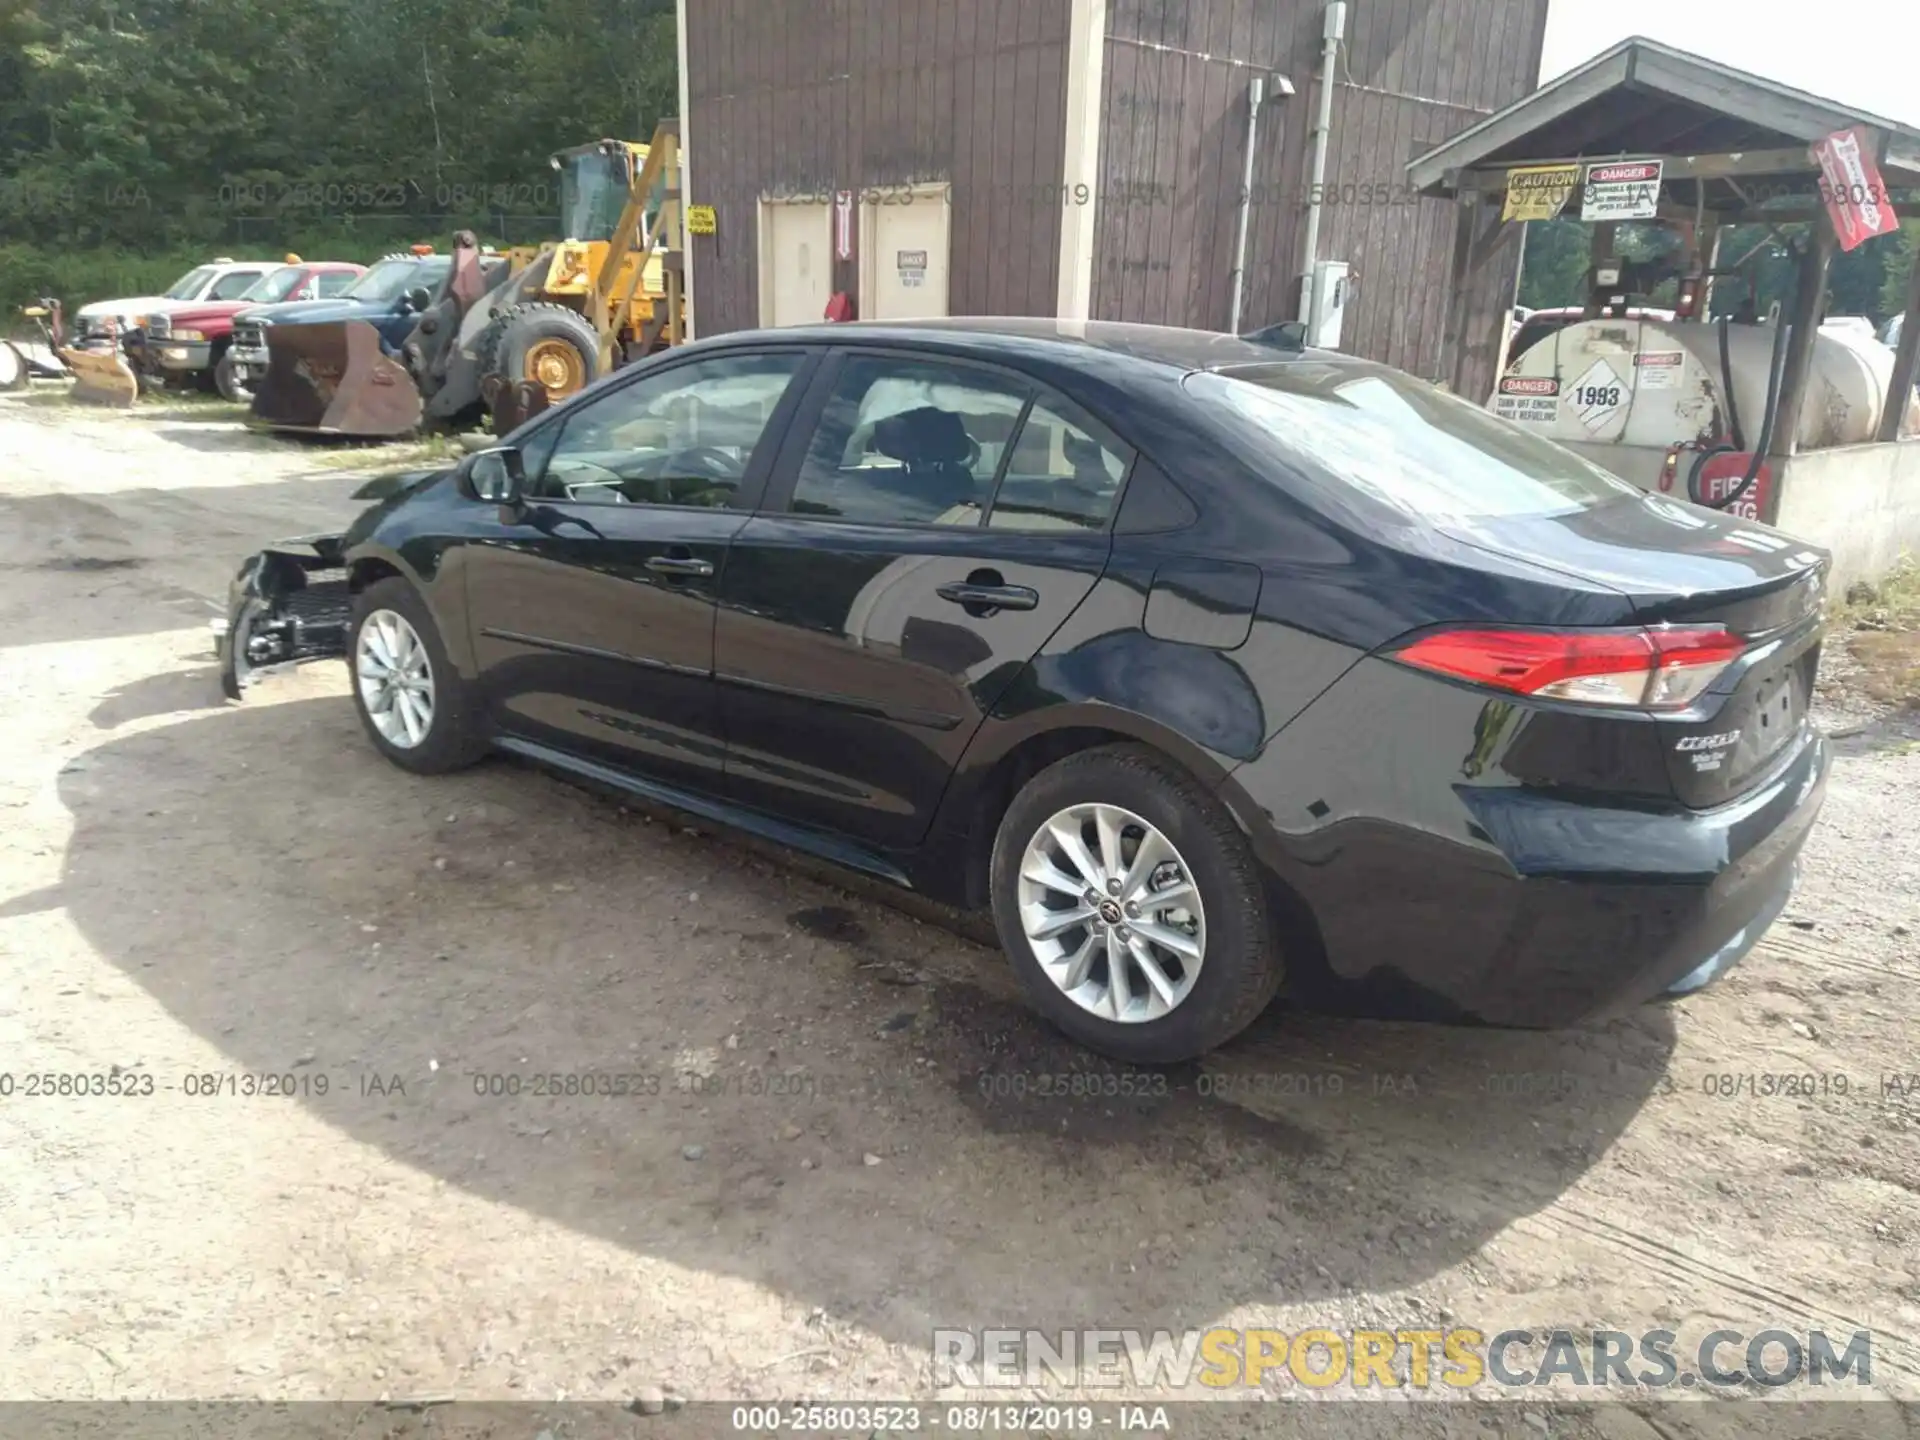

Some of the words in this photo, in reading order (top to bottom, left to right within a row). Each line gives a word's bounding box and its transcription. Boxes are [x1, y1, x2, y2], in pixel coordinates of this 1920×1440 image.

[1513, 171, 1574, 187] CAUTION
[1601, 167, 1646, 180] DANGER
[1508, 380, 1552, 392] DANGER
[1576, 387, 1620, 406] 1993
